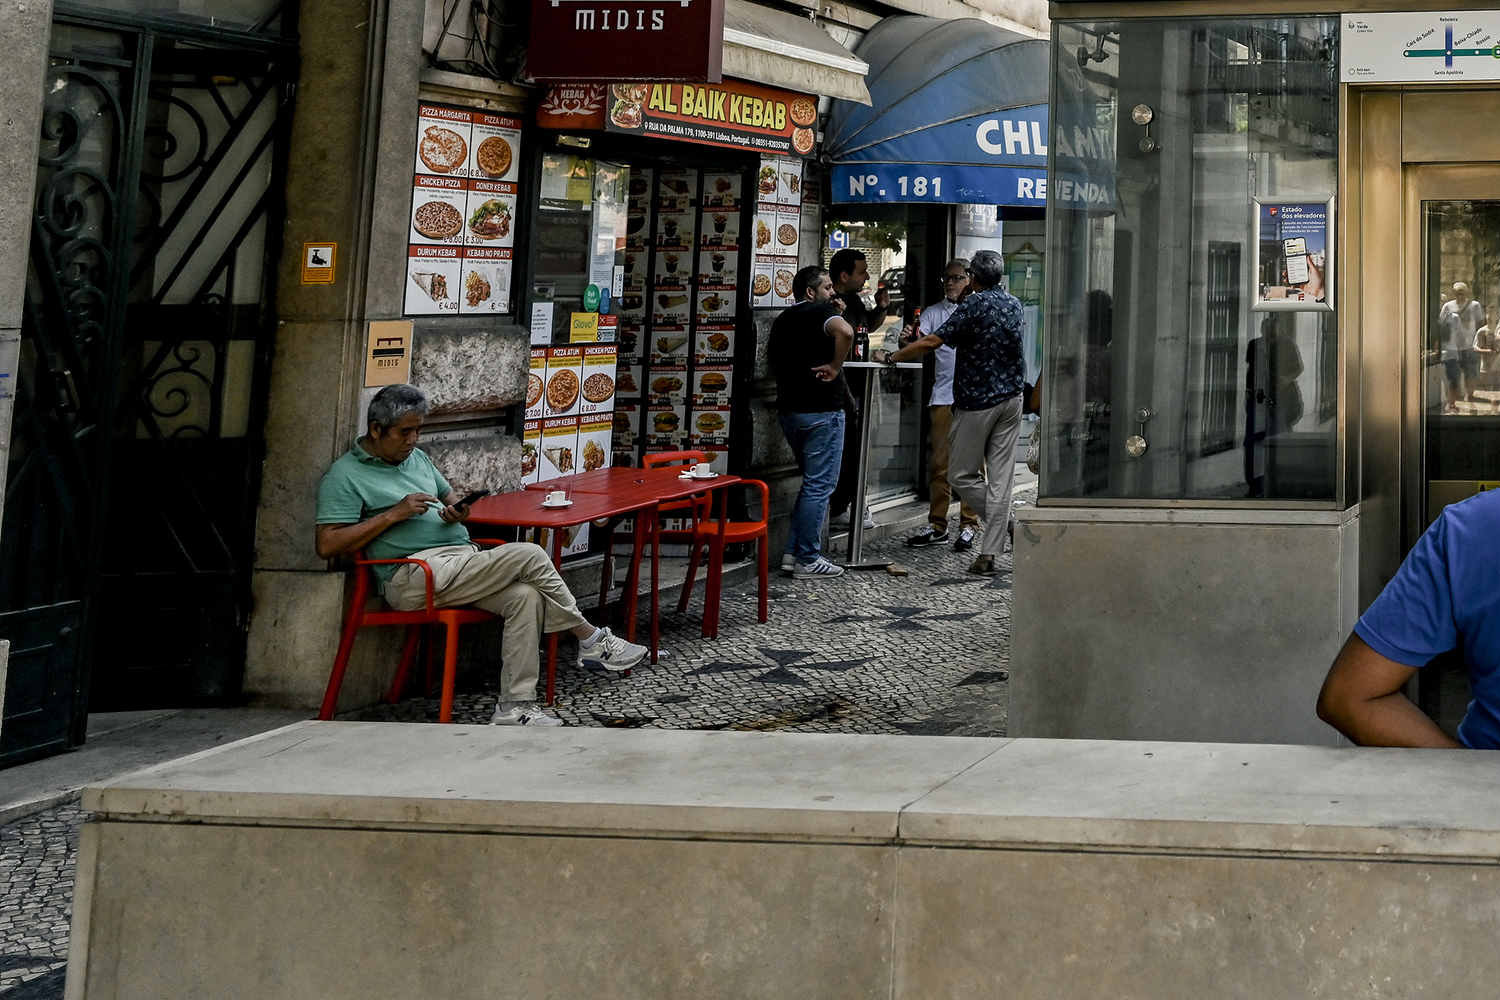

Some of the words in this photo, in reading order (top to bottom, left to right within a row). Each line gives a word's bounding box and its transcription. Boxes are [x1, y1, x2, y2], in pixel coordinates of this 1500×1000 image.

[575, 9, 665, 30] MIDIS
[1405, 40, 1416, 48] Cais
[1475, 34, 1491, 47] Rossio
[648, 84, 678, 113] AL
[681, 86, 727, 121] BAIK
[729, 91, 787, 131] KEBAB
[421, 107, 438, 117] PIZZA
[438, 109, 471, 121] MARGARITA
[484, 115, 499, 124] PIZZA
[500, 118, 514, 127] ATUM
[649, 122, 659, 131] RUA
[660, 124, 667, 132] DA
[667, 124, 685, 135] PALMA
[420, 177, 445, 187] CHICKEN
[445, 179, 461, 188] PIZZA
[475, 182, 493, 191] DONER
[493, 183, 511, 192] KEBAB
[898, 176, 942, 197] 181
[417, 248, 437, 256] DURUM
[437, 249, 457, 257] KEBAB
[467, 249, 484, 257] KEBAB
[484, 250, 492, 258] NO
[492, 250, 511, 258] PRATO
[444, 302, 458, 310] 4.00
[573, 319, 592, 330] Glovo
[567, 348, 580, 356] ATUM
[605, 346, 617, 354] PIZZA
[529, 409, 541, 417] 7.00
[585, 404, 597, 412] 8.00
[544, 419, 561, 428] DURUM
[561, 418, 577, 426] KEBAB
[581, 415, 595, 423] KEBAB
[600, 413, 613, 421] PRATO
